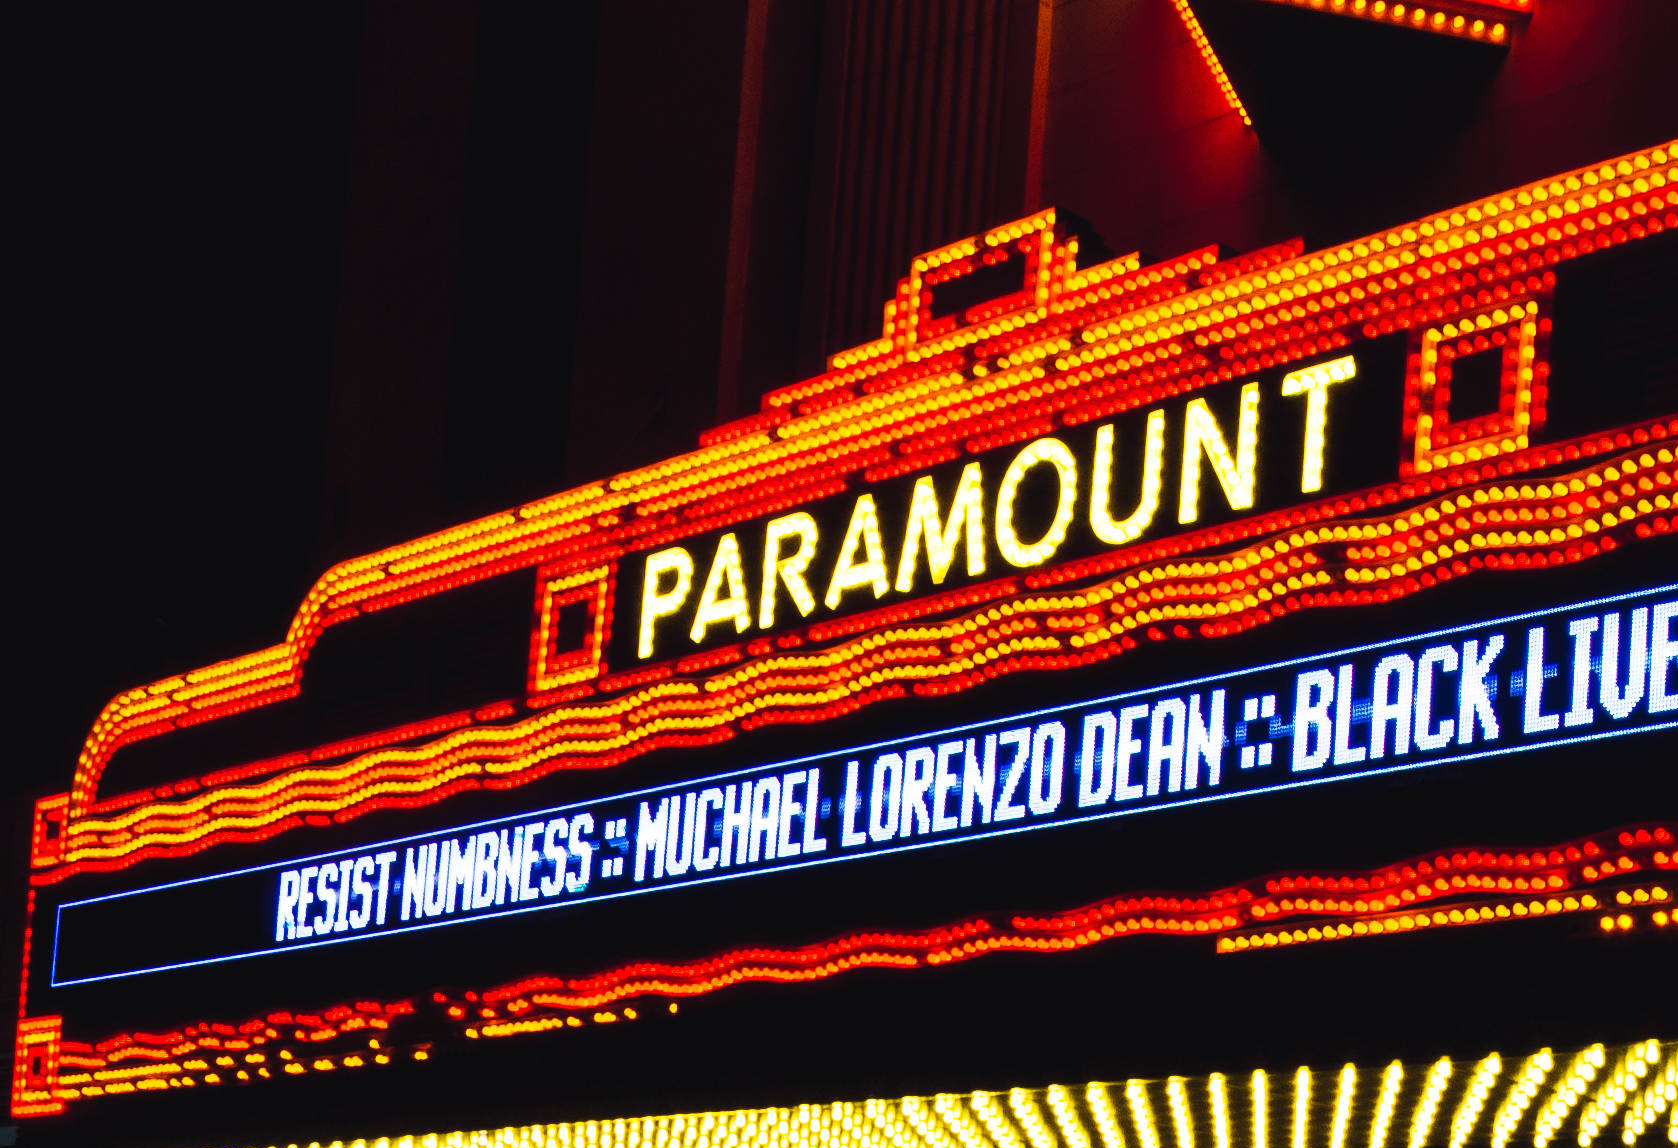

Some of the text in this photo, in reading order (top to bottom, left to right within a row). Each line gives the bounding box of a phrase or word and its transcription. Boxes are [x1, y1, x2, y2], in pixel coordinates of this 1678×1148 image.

[637, 355, 1357, 659] PARAMOUNT
[276, 851, 397, 941] RESIST
[401, 812, 595, 921] NUMBNESS
[634, 767, 827, 882] MUCHAEL
[840, 720, 1066, 847] LORENZO
[1076, 688, 1228, 808] DEAN
[1292, 634, 1505, 772] BLACK
